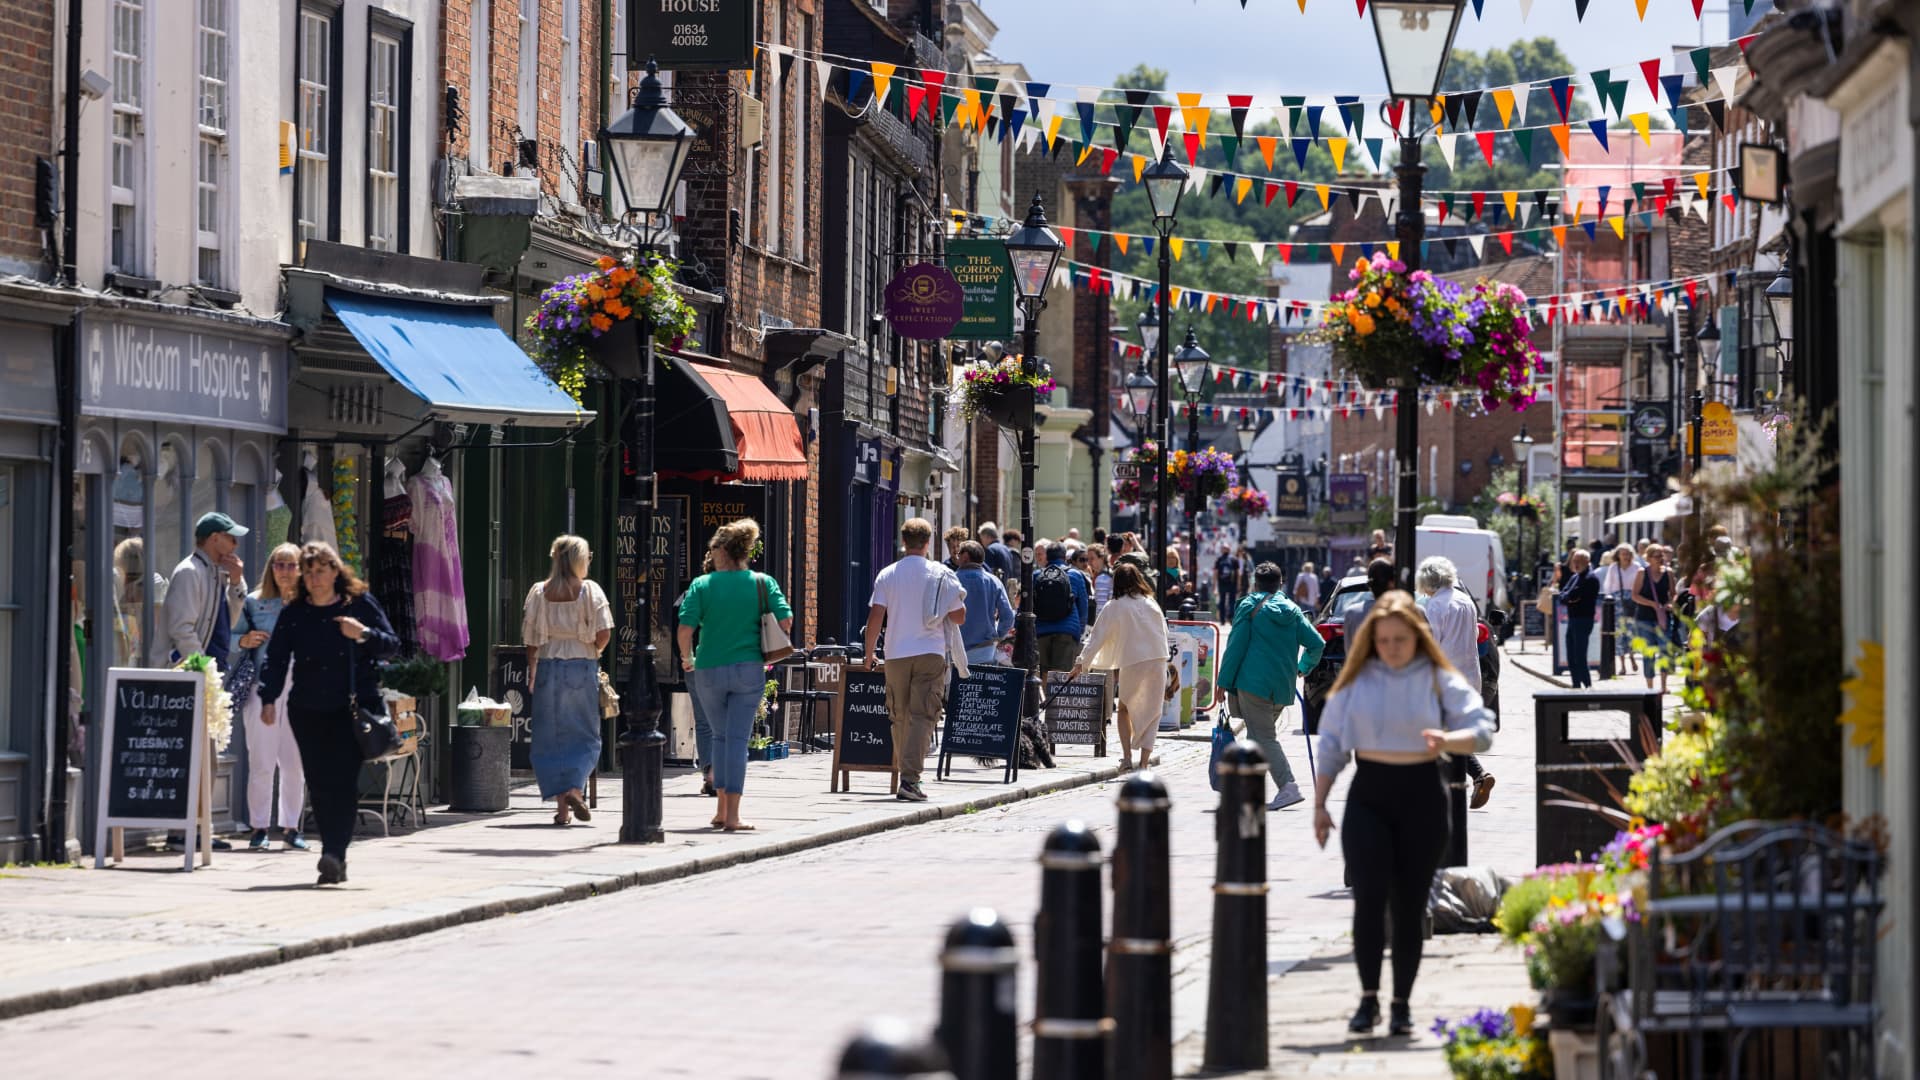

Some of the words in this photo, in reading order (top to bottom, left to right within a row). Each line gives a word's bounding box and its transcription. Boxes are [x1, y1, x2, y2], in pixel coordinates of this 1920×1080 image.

[661, 0, 720, 12] HOUSE
[673, 24, 705, 35] 01634
[671, 35, 708, 46] 400192
[967, 255, 992, 265] THE
[954, 265, 1003, 274] GORDON
[957, 274, 1000, 284] CHIPPY
[112, 323, 180, 392] Wisdom
[189, 333, 250, 416] Hospice
[701, 502, 722, 513] EYS
[725, 503, 745, 513] CUT
[500, 661, 523, 686] The
[849, 683, 865, 693] SET
[867, 684, 886, 694] MEN
[959, 684, 983, 692] COFFEE
[1069, 686, 1097, 695] DRINKS
[1056, 696, 1070, 706] TEA
[1072, 697, 1090, 707] CAKE
[1058, 708, 1088, 719] PANINIS
[1056, 720, 1090, 731] TOASTIES
